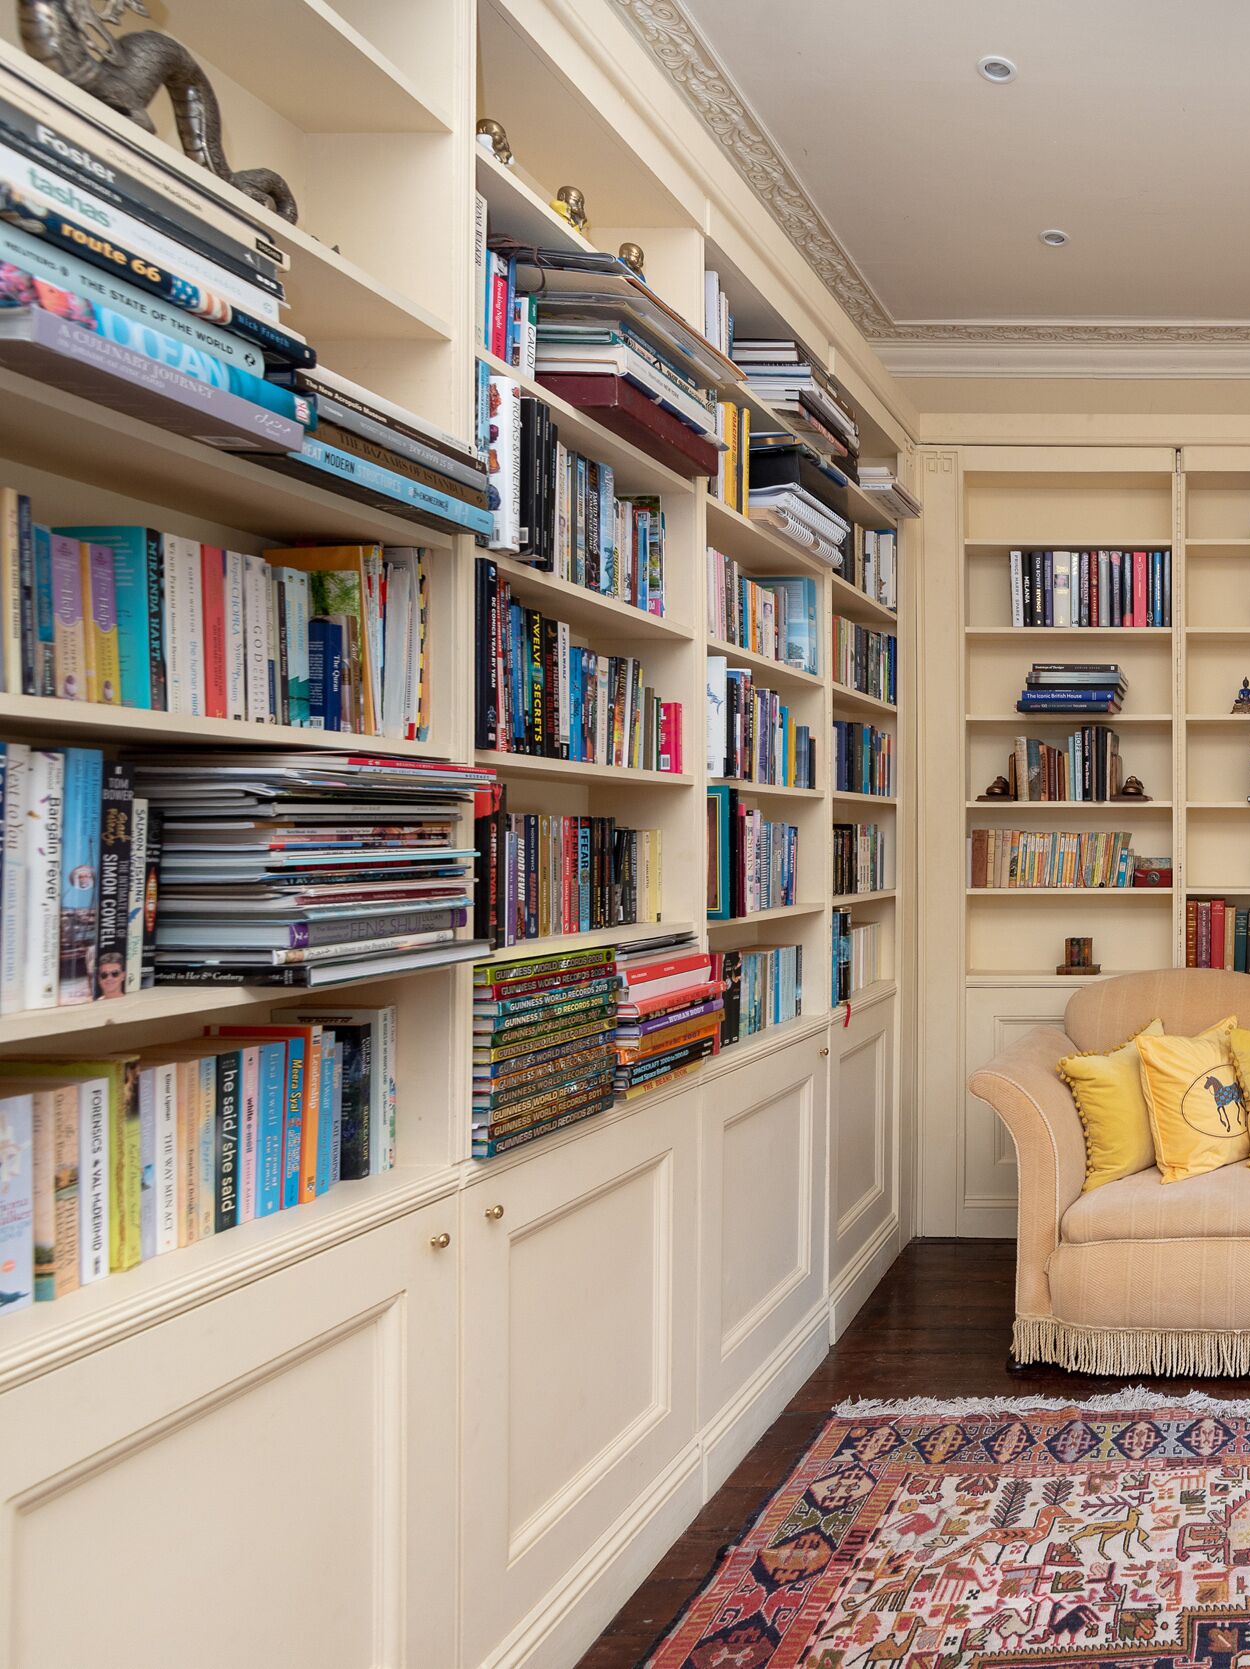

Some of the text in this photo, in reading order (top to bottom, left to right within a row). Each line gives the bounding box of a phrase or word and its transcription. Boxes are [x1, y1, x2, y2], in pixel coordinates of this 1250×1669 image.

[36, 124, 116, 184] Foster
[27, 166, 113, 228] tashas
[475, 196, 484, 267] FIONA WALKER
[60, 223, 162, 283] route 66
[80, 274, 234, 356] THE STATE OF THE WORLD
[494, 280, 504, 329] Breaking Night
[57, 324, 71, 340] A
[149, 363, 216, 401] JOURNEY
[98, 306, 230, 393] OCEAN
[527, 326, 537, 370] GAUDI
[304, 378, 388, 424] The New Acropolis Museum
[512, 401, 521, 515] ROCKS & MINERALS
[149, 541, 162, 661] MIRANDA HART
[491, 596, 497, 607] DC
[190, 641, 200, 656] the
[253, 626, 262, 663] GOD
[279, 640, 287, 655] Tiger
[491, 657, 497, 666] BY
[191, 659, 200, 690] human
[280, 656, 288, 676] Rising
[331, 655, 341, 692] The Quran
[532, 613, 542, 742] TWELVE SECRETS
[546, 654, 554, 693] SUZANNE
[191, 692, 201, 717] mind
[7, 759, 24, 850] Next to You
[108, 777, 129, 791] TOM
[46, 797, 61, 901] Bargain Fever
[135, 809, 146, 851] SALMON
[517, 837, 525, 902] BLOOD FEVER
[571, 834, 579, 875] ENEMY
[580, 835, 590, 869] FEAR
[100, 852, 118, 949] SIMON COWELL
[116, 859, 128, 938] THE INTIMATE LIFE OF
[350, 919, 385, 939] FENG
[390, 915, 419, 935] SHUI
[184, 971, 200, 981] Her
[212, 971, 244, 983] Century
[510, 983, 608, 1012] GUINNESS WORLD RECORDS 2019
[504, 997, 604, 1028] GUINNESS WORLD RECORDS 2018
[668, 1005, 705, 1023] HUMAN BODY
[223, 1070, 237, 1093] he
[267, 1053, 279, 1126] Lisa Jewell
[290, 1060, 303, 1090] Meera
[308, 1054, 320, 1109] Leadership
[498, 1061, 606, 1103] GUINNESS WORLD RECORDS 2013
[643, 1068, 688, 1093] THE BEANO BOOK
[246, 1097, 254, 1122] white
[289, 1092, 302, 1113] Syal
[493, 1074, 606, 1122] GUINNESS WORLD RECORDS 2012
[494, 1088, 602, 1137] GUINNESS WORLD RECORDS 2011
[91, 1089, 103, 1154] FORENSICS
[496, 1102, 603, 1152] GUINNESS WORLD RECORDS 2010
[92, 1169, 103, 1191] VAL
[164, 1133, 173, 1232] THE WAY MEN ACT
[221, 1176, 236, 1213] said
